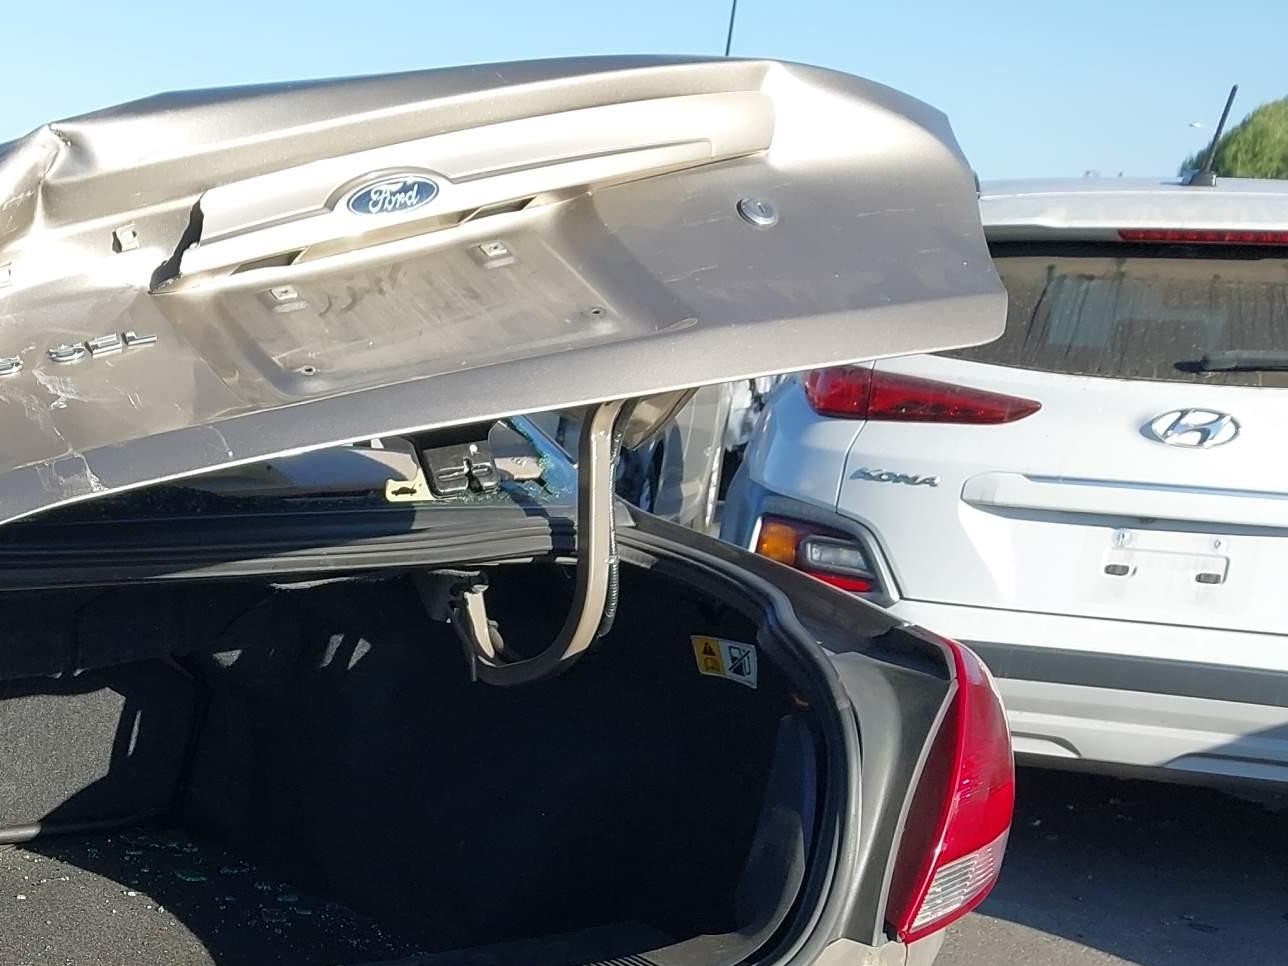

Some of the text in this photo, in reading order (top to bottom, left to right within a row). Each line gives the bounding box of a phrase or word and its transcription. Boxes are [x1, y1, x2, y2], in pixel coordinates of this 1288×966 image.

[368, 181, 421, 214] Ford
[48, 330, 158, 364] SEL
[850, 467, 940, 487] KONA
